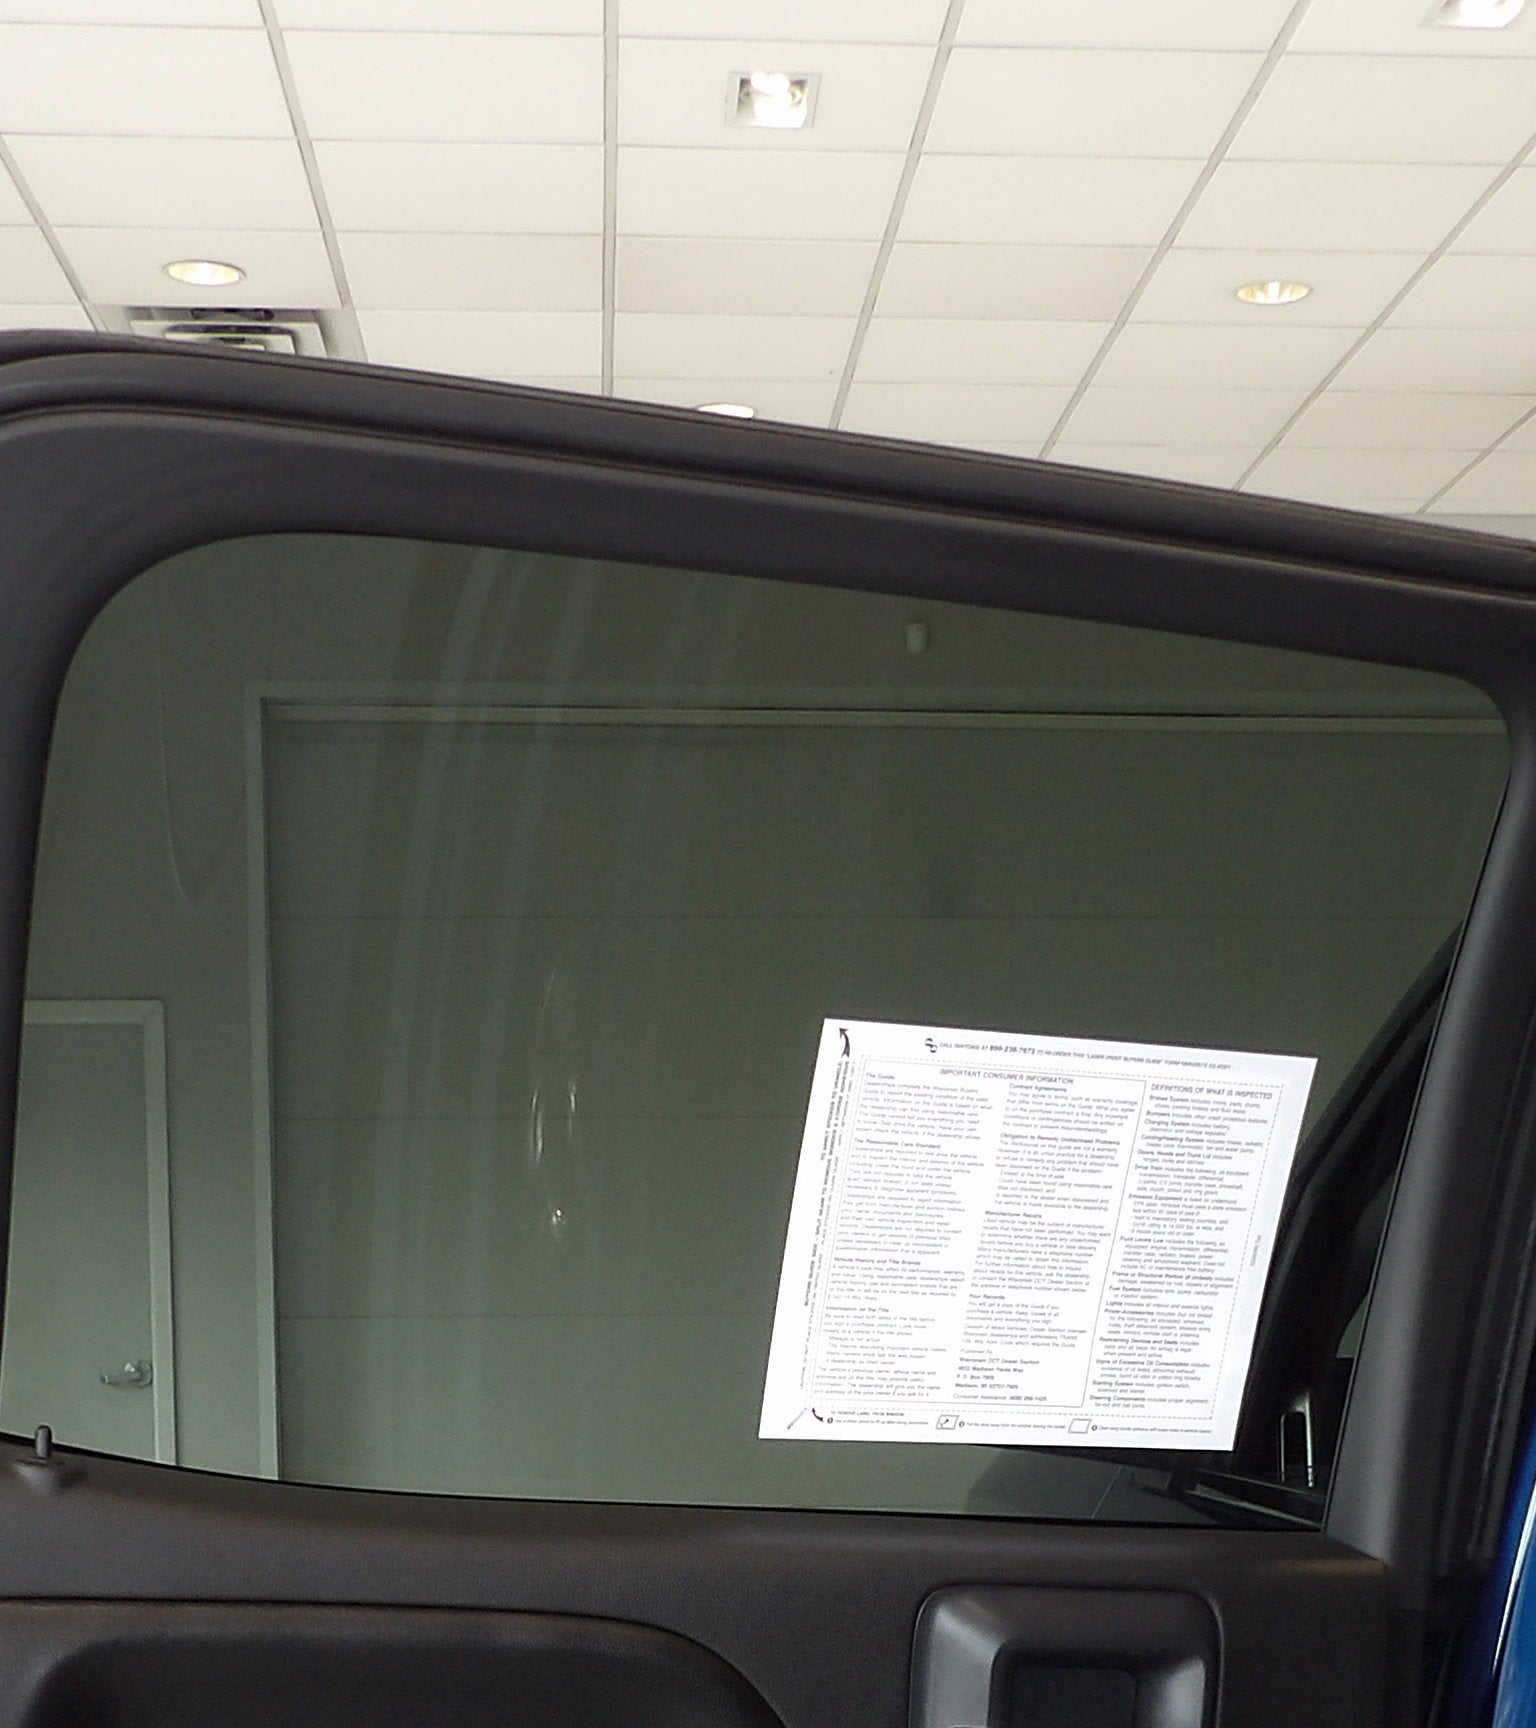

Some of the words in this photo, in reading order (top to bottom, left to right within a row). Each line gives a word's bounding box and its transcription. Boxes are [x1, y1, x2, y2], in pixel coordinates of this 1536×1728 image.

[940, 1068, 980, 1077] IMPORTANT
[983, 1072, 1023, 1080] CONSUMER
[1025, 1075, 1073, 1084] INFORMATION
[1150, 1084, 1193, 1092] DEFINITIONS
[1234, 1090, 1272, 1099] INSPECTED
